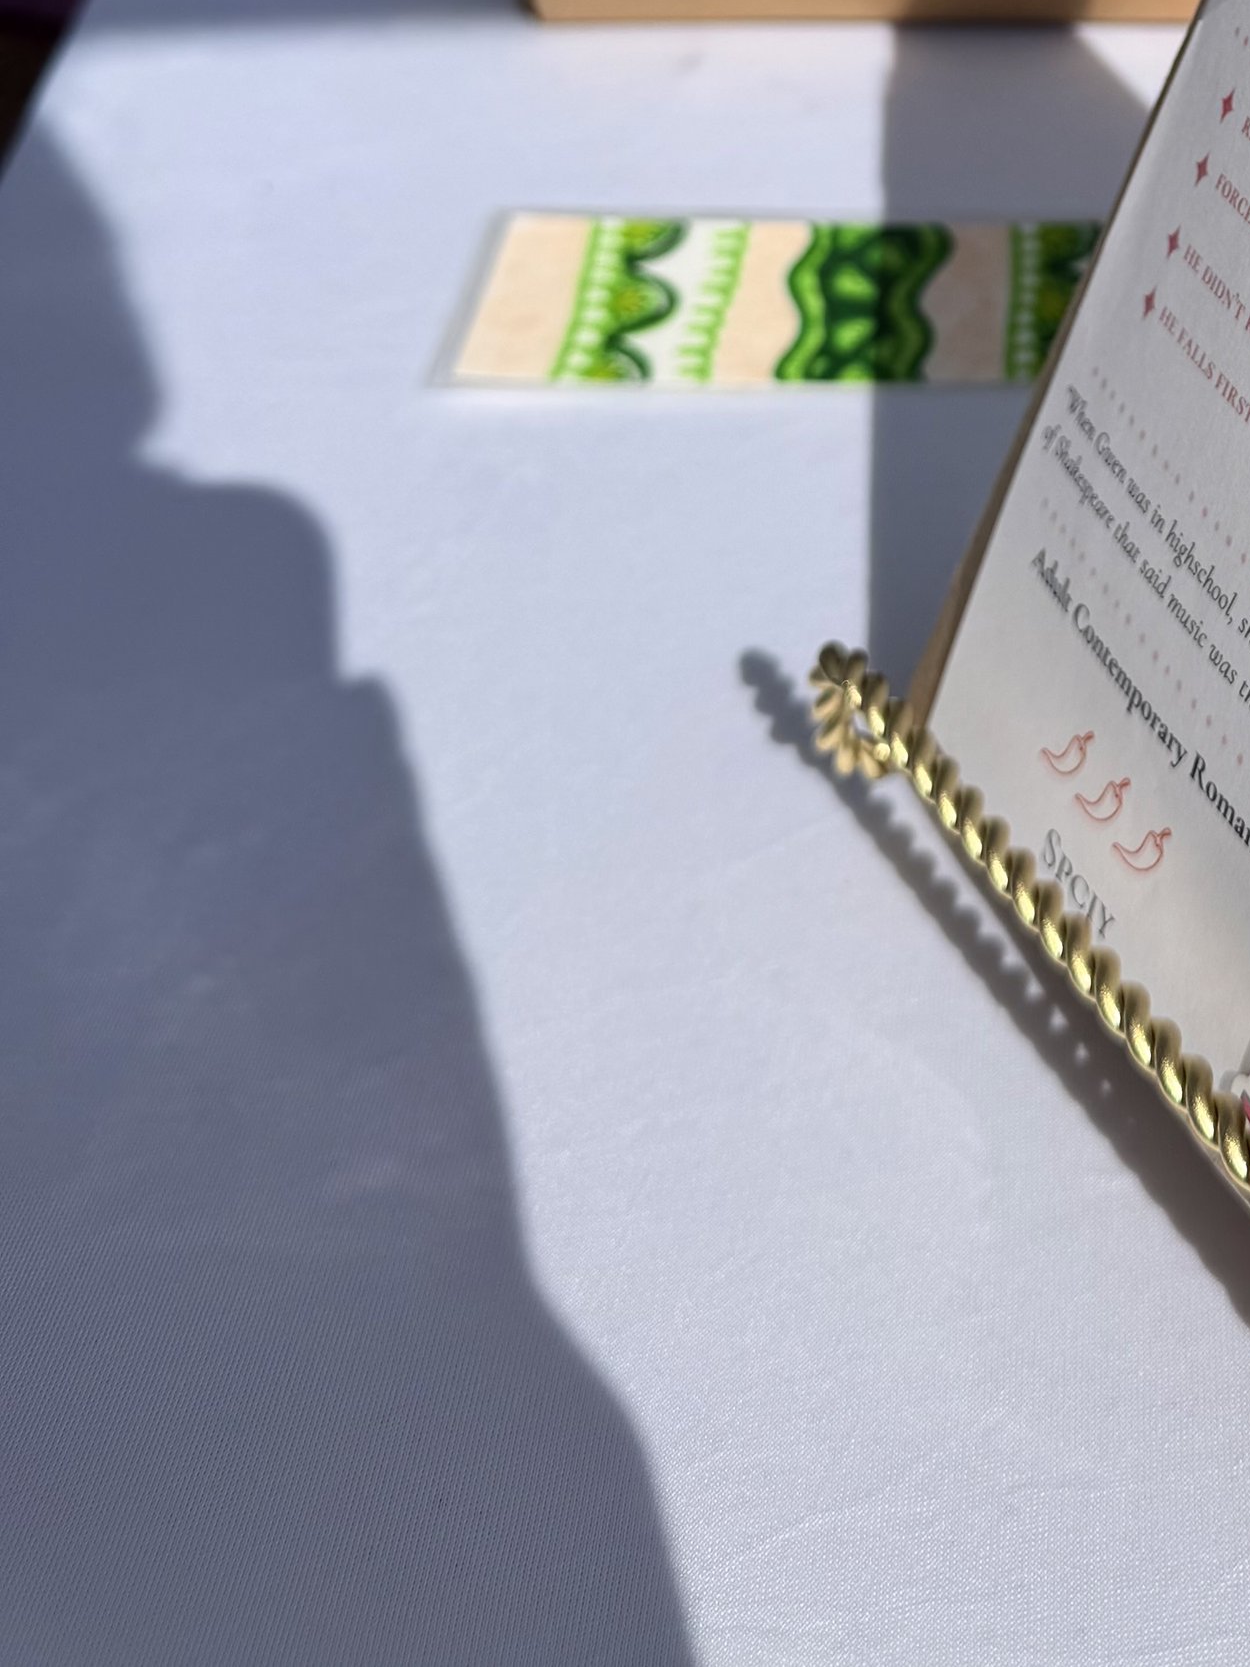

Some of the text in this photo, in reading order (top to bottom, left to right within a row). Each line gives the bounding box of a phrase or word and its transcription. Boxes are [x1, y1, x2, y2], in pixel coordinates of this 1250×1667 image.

[1159, 306, 1178, 336] HE
[1176, 327, 1216, 381] FALLS
[1183, 244, 1202, 275] HE
[1201, 265, 1246, 321] DIDN'T
[1042, 423, 1062, 451] of
[1053, 434, 1116, 530] Shakespeare
[1112, 520, 1142, 565] that
[1138, 558, 1172, 600] said
[1167, 593, 1208, 649] music
[1208, 642, 1238, 686] was
[1094, 431, 1128, 485] Gwen
[1127, 477, 1151, 515] was
[1150, 503, 1166, 535] in
[1164, 519, 1238, 626] highschool,
[1029, 547, 1073, 613] Adult
[1072, 602, 1188, 769] Contemporary
